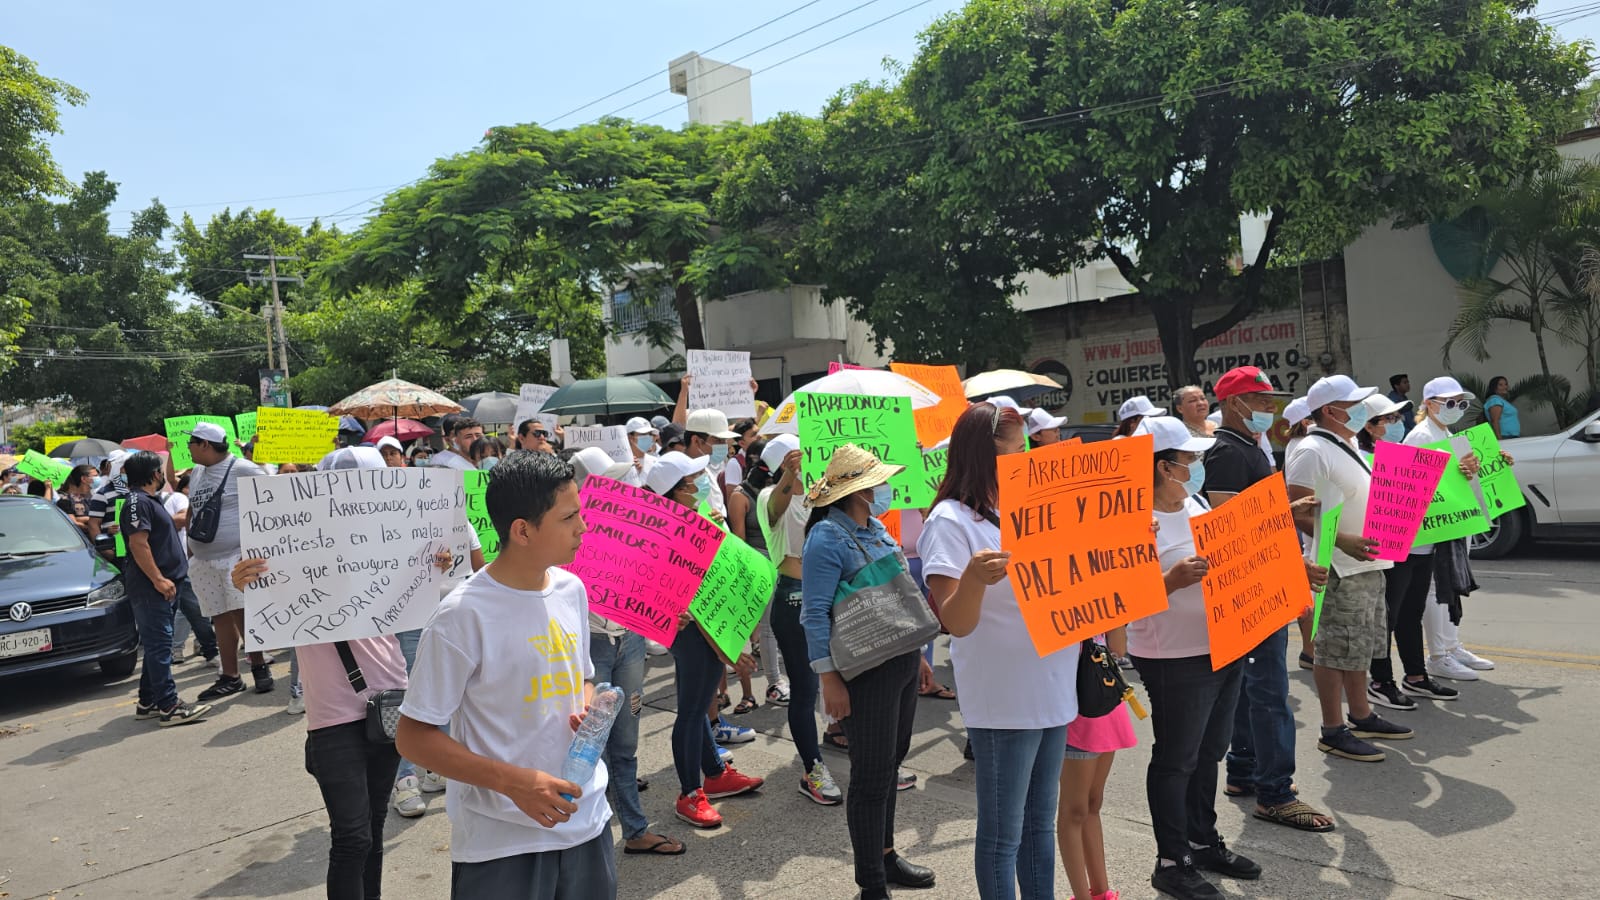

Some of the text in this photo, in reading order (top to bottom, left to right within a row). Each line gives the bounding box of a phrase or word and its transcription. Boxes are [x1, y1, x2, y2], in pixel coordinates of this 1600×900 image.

[1194, 351, 1280, 376] OMPRAR
[825, 415, 870, 437] VETE
[803, 446, 812, 463] Y
[1028, 447, 1120, 488] ARREDONDO
[252, 468, 432, 505] La INEPTITUD de
[243, 511, 312, 533] RODRIGO
[329, 497, 412, 518] ARREDONDO,
[416, 498, 449, 518] queda
[584, 494, 707, 554] TRABAJAR A LOS
[1010, 487, 1147, 540] VETE Y DALE
[1241, 496, 1265, 519] TOTAL
[247, 521, 443, 559] manifiesta en las malas
[697, 517, 723, 542] DEJA
[302, 566, 329, 585] que
[336, 555, 399, 576] inaugura
[1015, 543, 1159, 601] PAZ A NUESTRA
[589, 583, 672, 632] SPERANZA
[1051, 592, 1127, 636] CUAUTLA
[1212, 604, 1226, 624] DE
